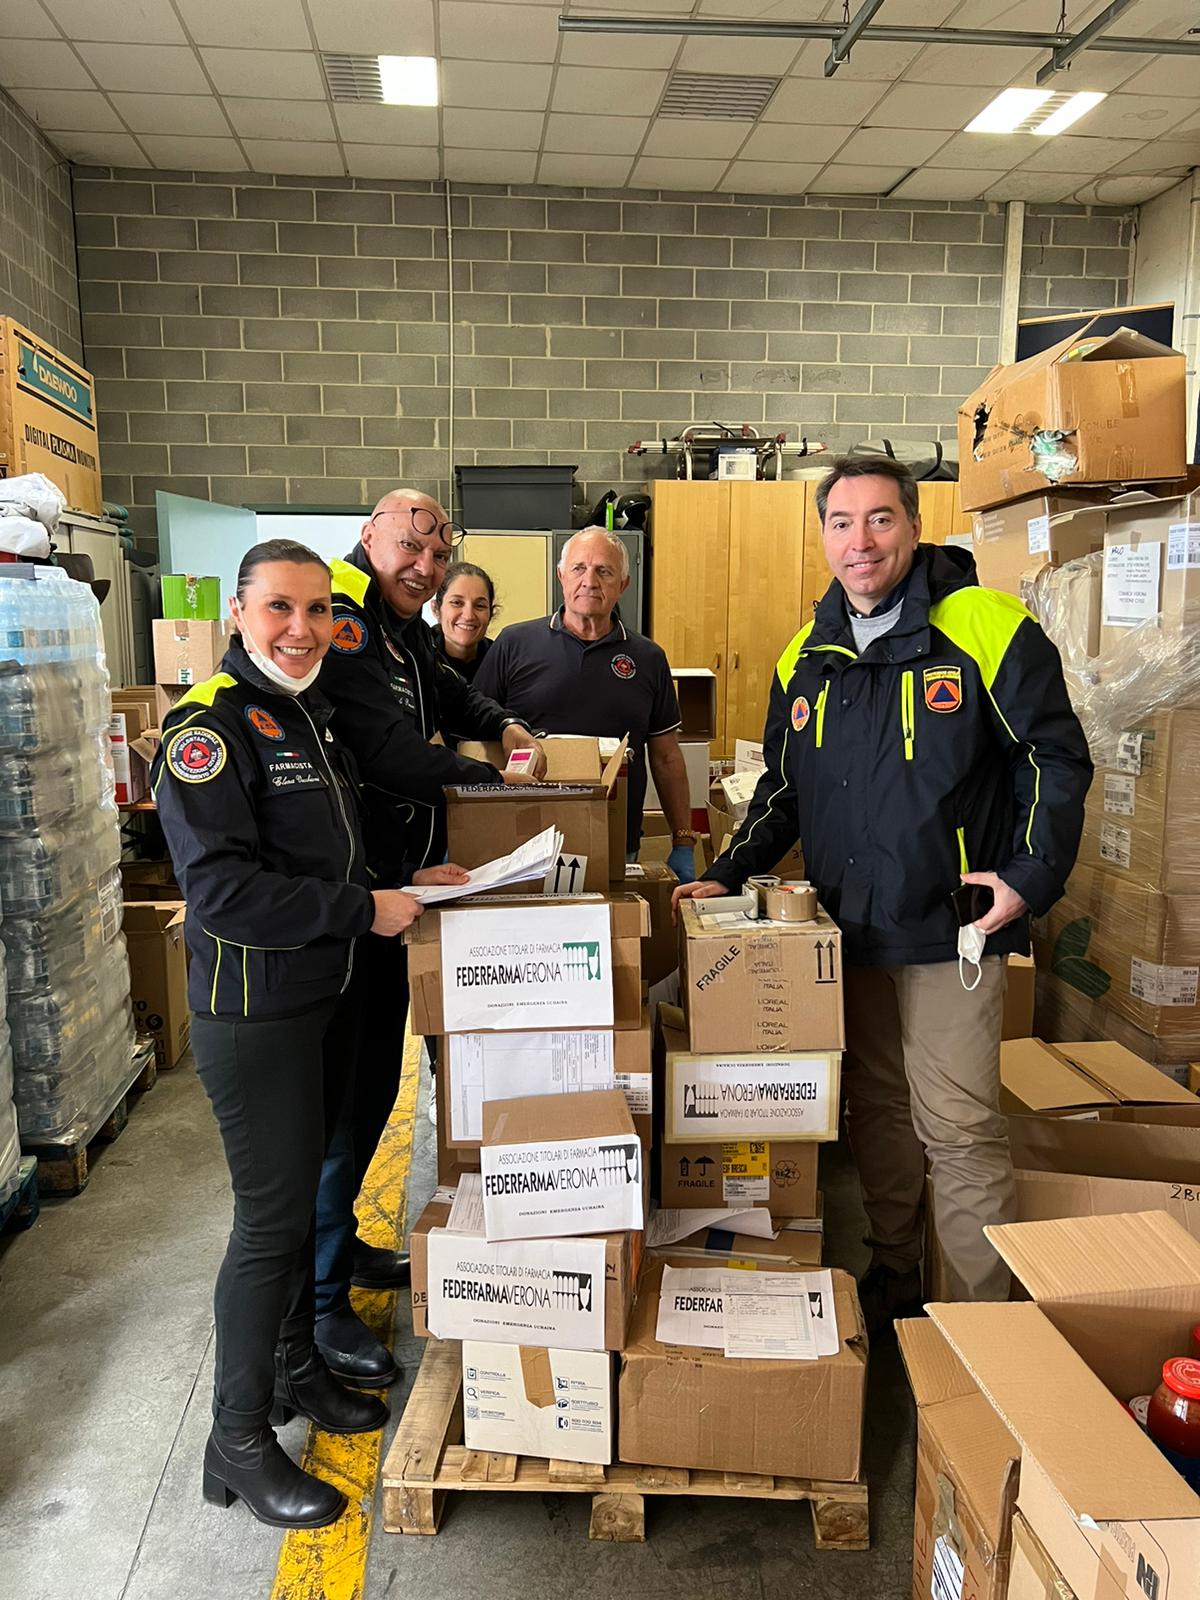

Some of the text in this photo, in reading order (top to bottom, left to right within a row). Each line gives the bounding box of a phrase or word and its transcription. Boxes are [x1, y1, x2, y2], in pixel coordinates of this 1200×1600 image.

[38, 364, 78, 403] DAEWOO
[24, 423, 51, 451] DIGITAL
[51, 436, 76, 461] PLASMA
[269, 762, 313, 772] FARMACISTA
[469, 944, 507, 958] ASSOCIAZIONE
[529, 942, 535, 954] DI
[535, 941, 562, 954] FARMACIA
[456, 962, 564, 987] FEDERFARMAVERONA
[696, 945, 741, 991] FRAGILE
[720, 1082, 817, 1101] FEDERFARMAVERONA
[719, 1108, 743, 1118] FARMACIA
[769, 1108, 804, 1118] ASSOCIAZIONE
[498, 1146, 598, 1165] ASSOCIAZIONE TITOLARI DI FARMACIA
[485, 1168, 599, 1197] FEDERFARMAVERONA
[678, 1180, 715, 1188] FRAGILE
[456, 1261, 496, 1275] ASSOCIAZIONE
[518, 1266, 523, 1277] DI
[524, 1266, 552, 1280] FARMACIA
[443, 1278, 552, 1309] FEDERFARMAVERONA
[674, 1296, 723, 1313] FEDERFAR
